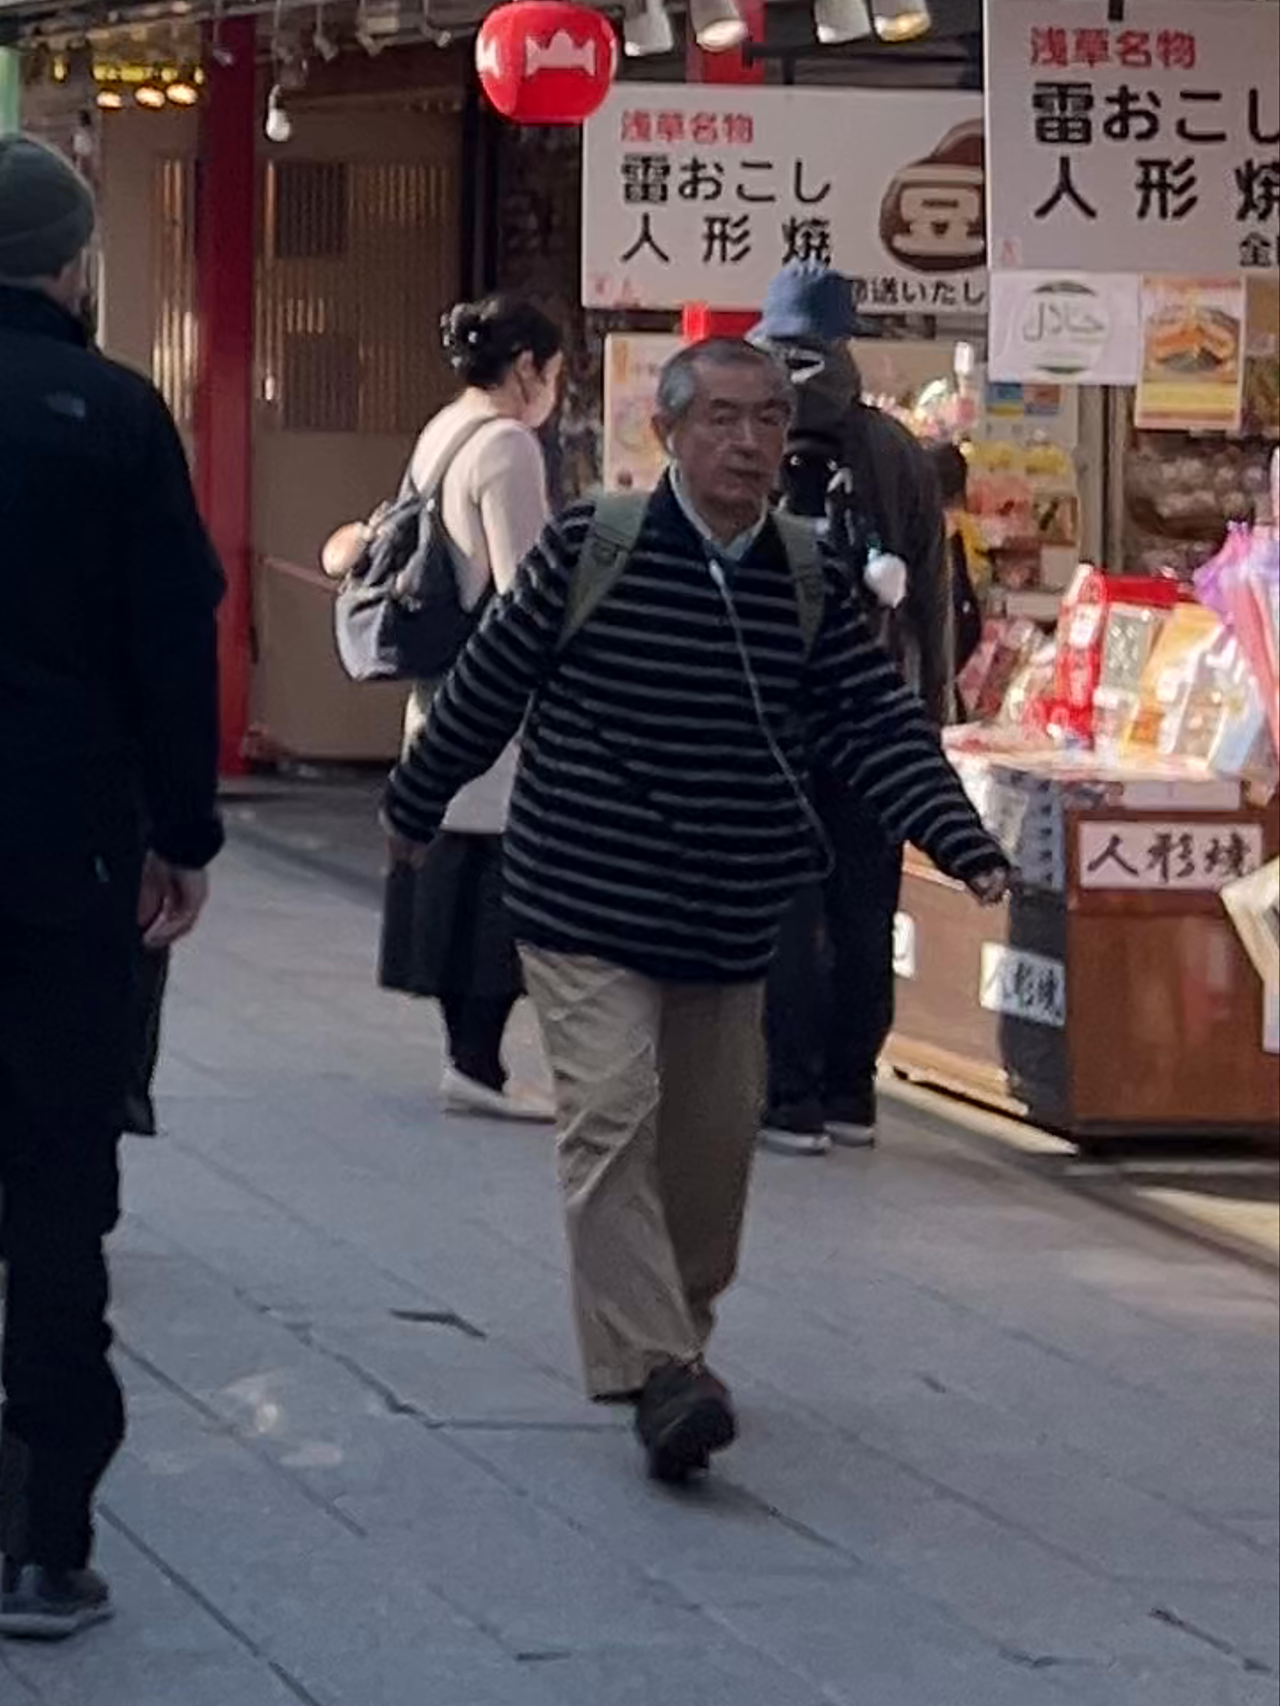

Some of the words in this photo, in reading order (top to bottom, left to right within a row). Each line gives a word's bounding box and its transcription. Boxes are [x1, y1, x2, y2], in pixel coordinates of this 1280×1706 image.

[1031, 27, 1197, 70] 浅草名物
[621, 110, 754, 145] 浅草名物
[1032, 82, 1280, 145] 雷おこし
[621, 153, 831, 205] 雷おこし
[1034, 155, 1280, 221] 人形焼
[621, 212, 832, 266] 人形焼
[1022, 301, 1105, 343] حلال
[1087, 832, 1252, 884] 人形焼
